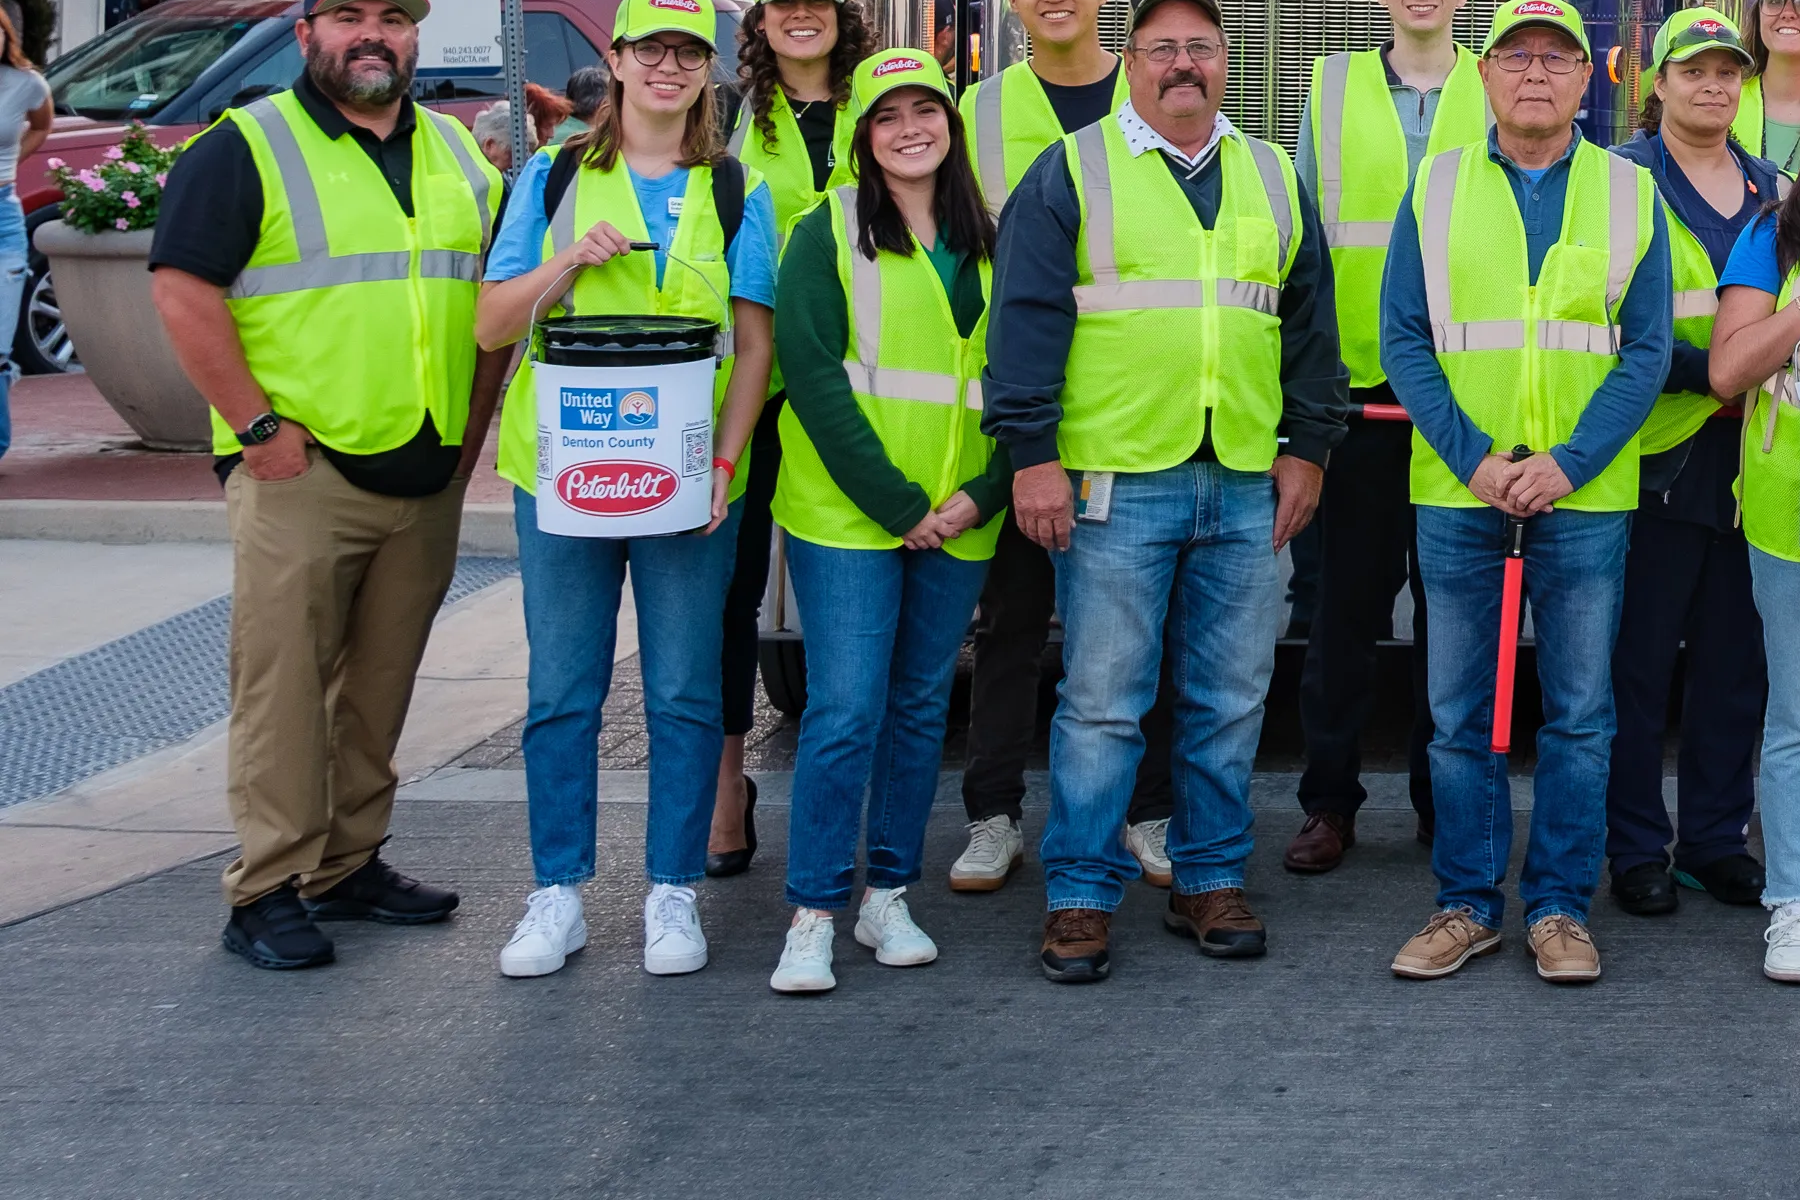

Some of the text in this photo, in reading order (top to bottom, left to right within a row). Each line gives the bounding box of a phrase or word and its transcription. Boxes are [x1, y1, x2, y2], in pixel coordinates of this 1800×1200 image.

[1518, 3, 1560, 15] Peterbilt
[443, 46, 491, 54] 940.243.0077
[877, 59, 918, 76] Peterbilt
[562, 392, 613, 409] United
[580, 409, 613, 429] Way
[562, 435, 655, 449] Denton County
[566, 469, 670, 500] Peterbilt
